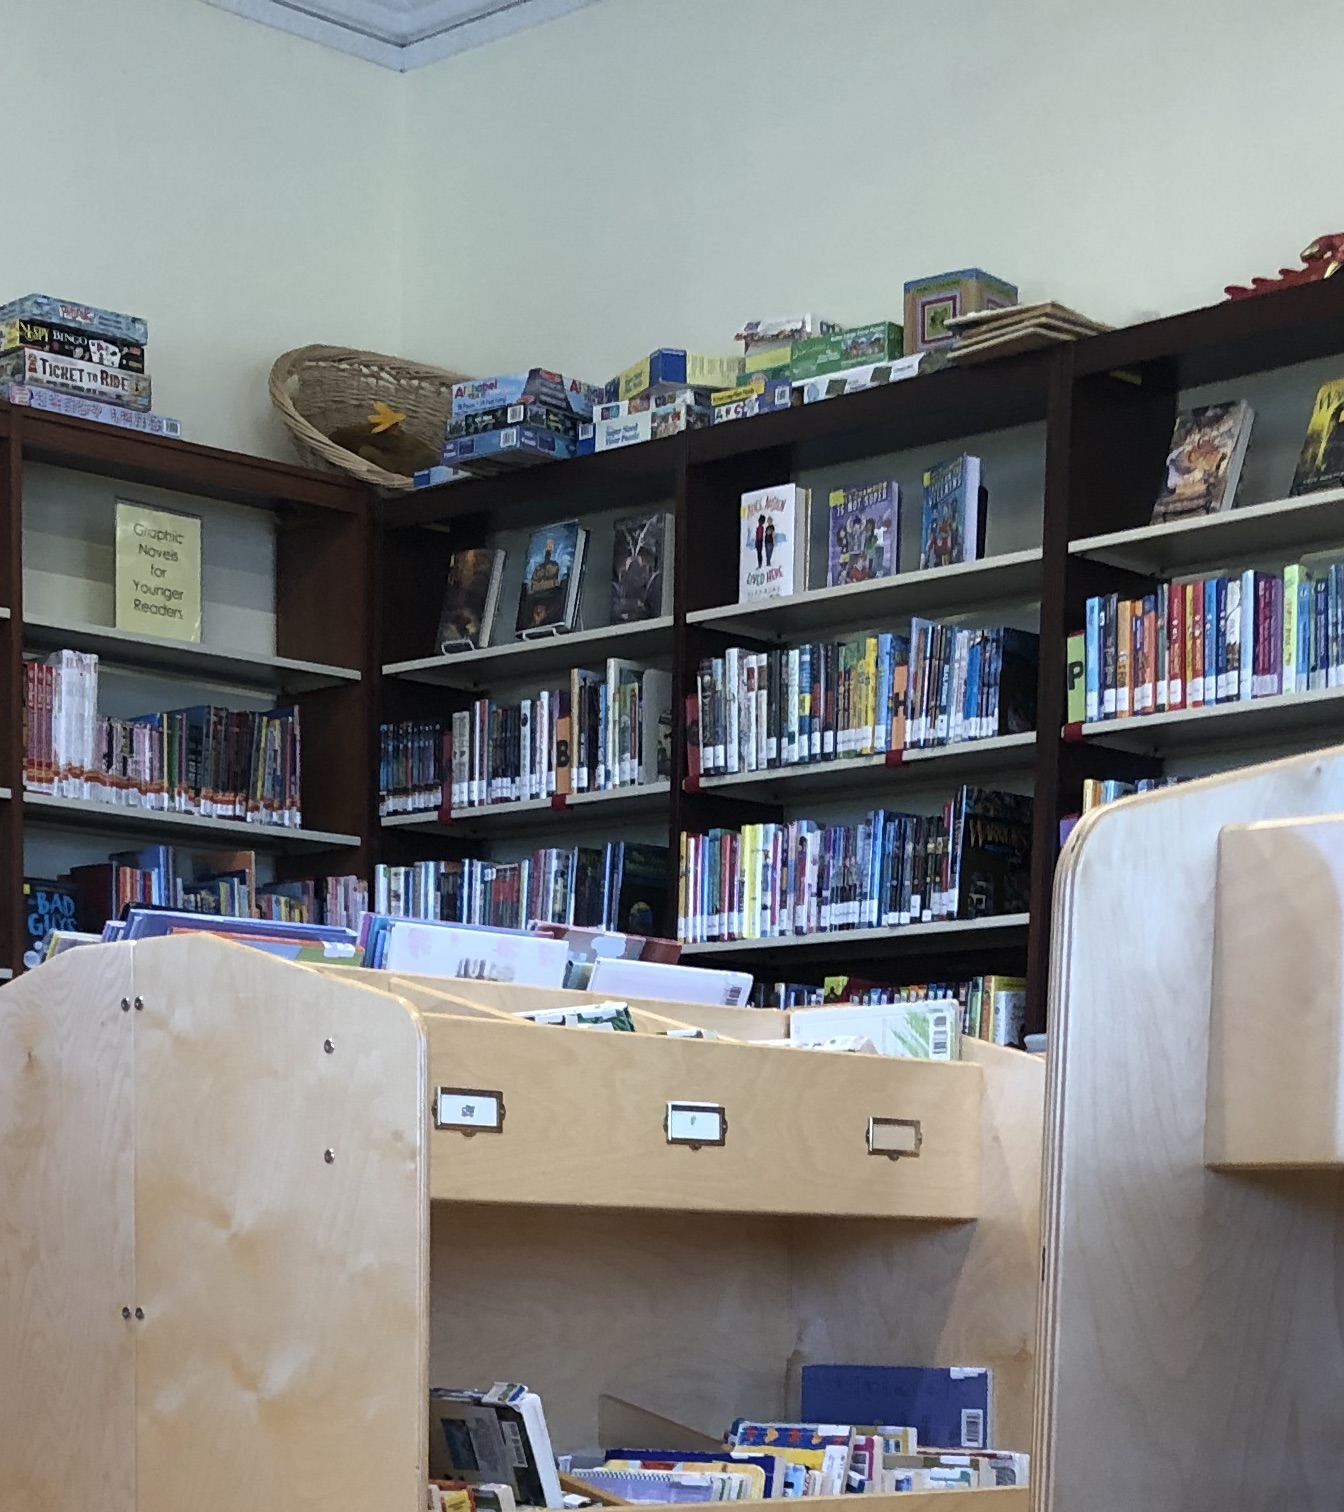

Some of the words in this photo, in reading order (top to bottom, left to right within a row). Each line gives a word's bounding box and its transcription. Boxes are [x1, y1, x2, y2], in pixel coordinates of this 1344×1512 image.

[52, 329, 88, 347] BINGO
[40, 356, 85, 384] TICKET
[100, 369, 130, 393] RIDE
[133, 523, 185, 546] Graphic
[138, 543, 179, 563] Novels
[150, 563, 168, 579] for
[132, 579, 185, 602] Younger
[133, 598, 184, 620] Readers
[1069, 661, 1084, 690] P
[36, 891, 76, 917] BAD
